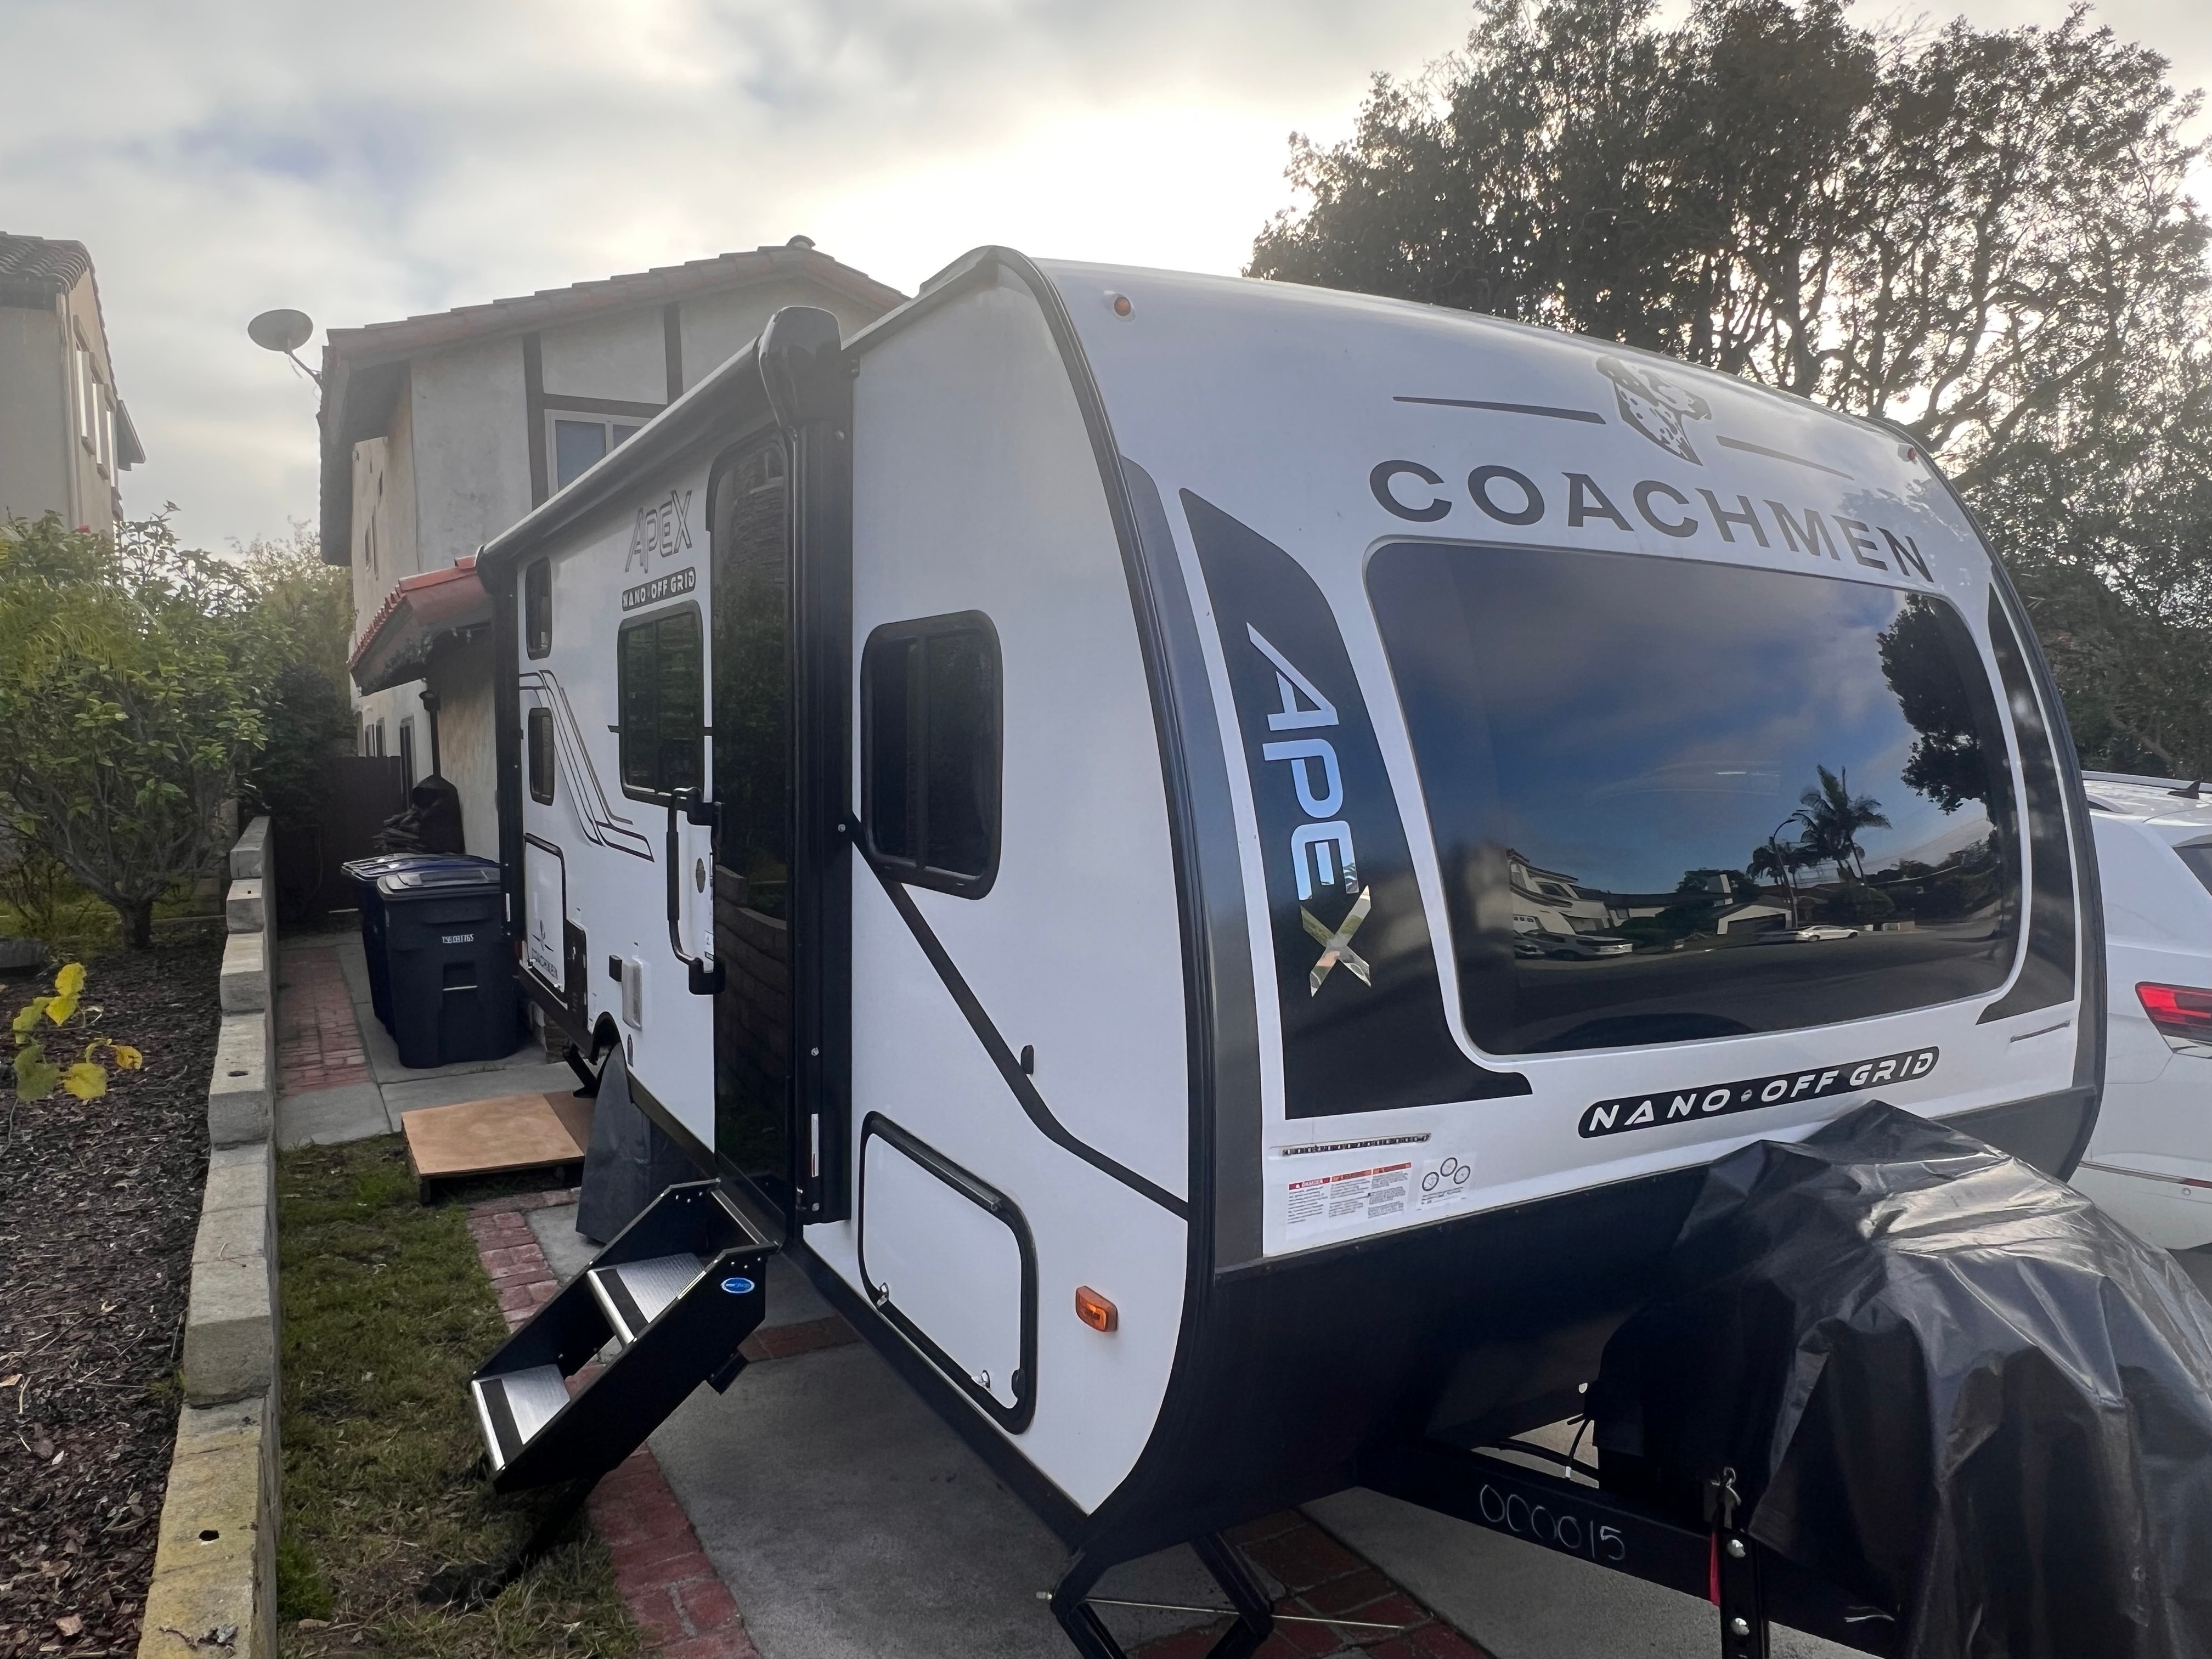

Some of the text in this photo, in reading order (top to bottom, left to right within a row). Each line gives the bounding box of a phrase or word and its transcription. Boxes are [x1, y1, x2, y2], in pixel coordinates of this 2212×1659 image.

[625, 490, 692, 574] APEX
[1370, 460, 1934, 583] COACHMEN
[623, 571, 695, 608] NANO OFF GRID
[1246, 622, 1372, 998] APEX
[1589, 1052, 1934, 1131] NANO OFF GRID
[1480, 1484, 1626, 1561] 000015
